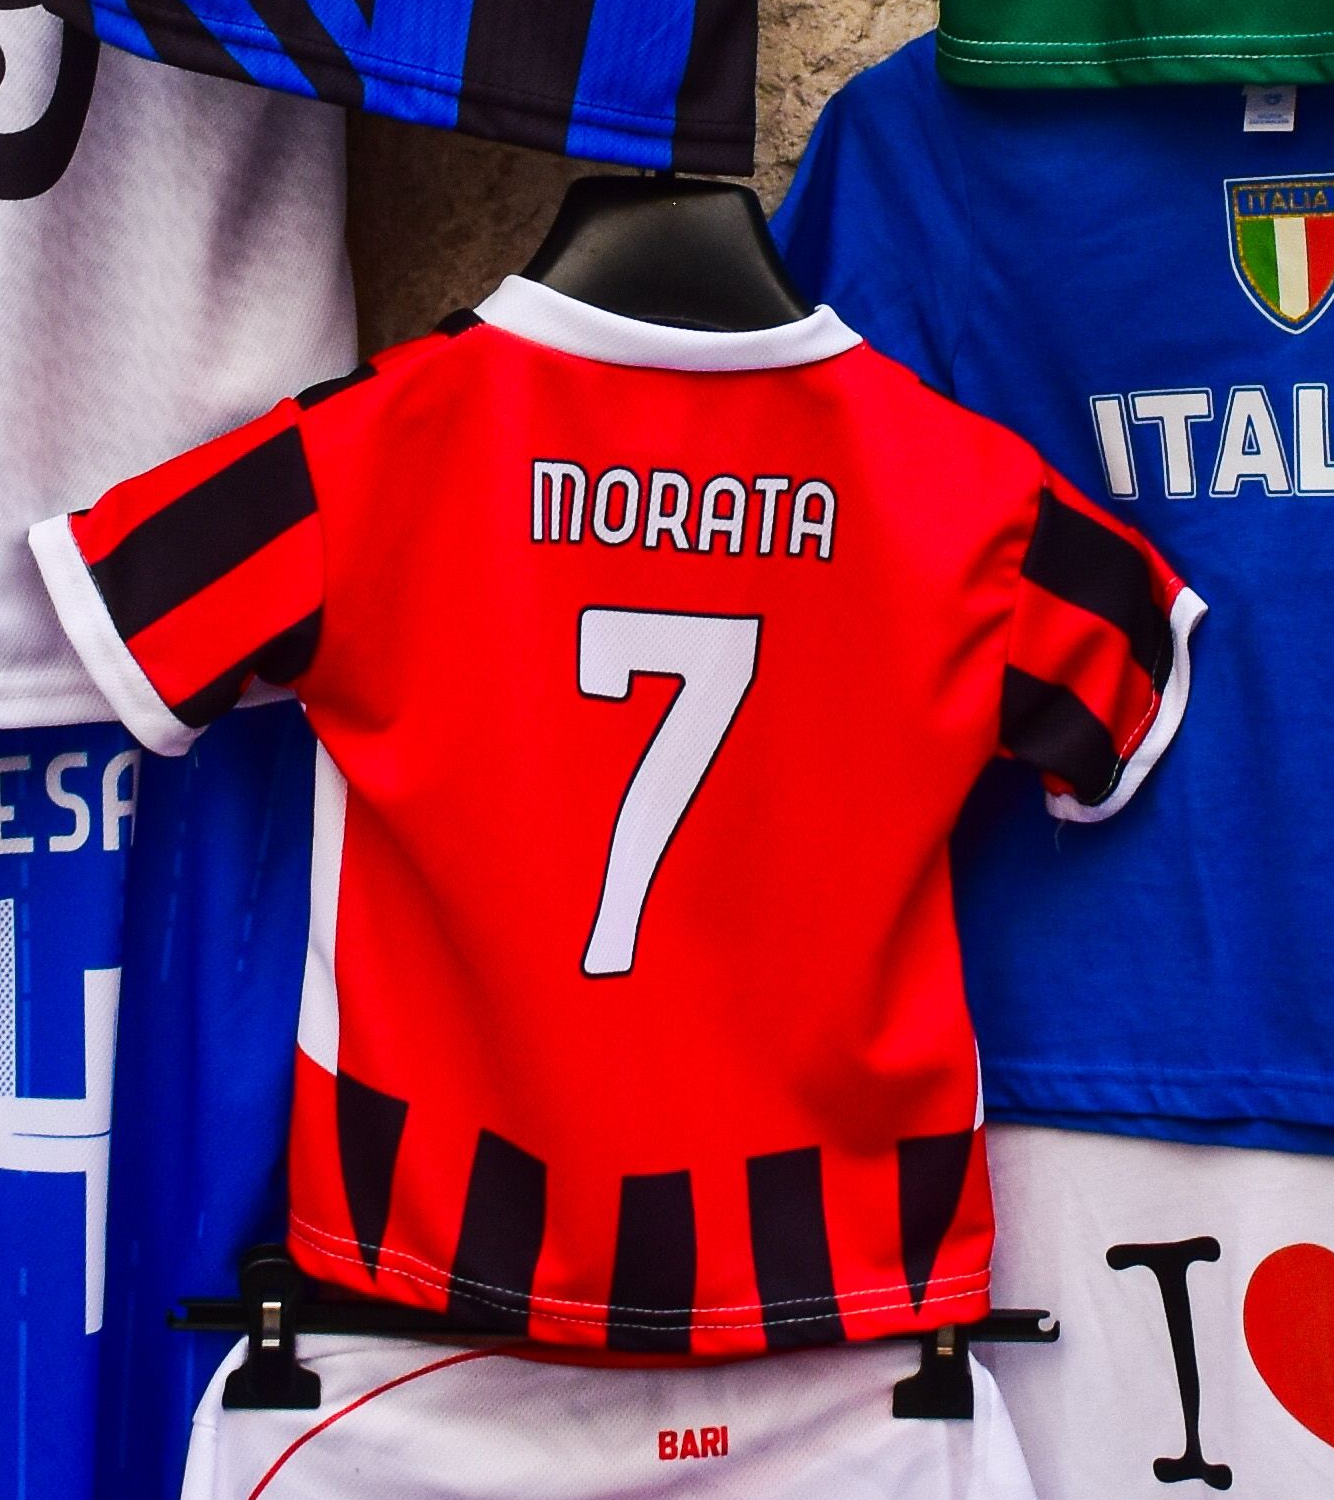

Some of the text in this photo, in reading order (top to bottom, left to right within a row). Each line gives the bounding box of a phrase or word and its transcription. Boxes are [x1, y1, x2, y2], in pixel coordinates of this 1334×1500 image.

[1246, 189, 1329, 212] ITALIA
[531, 458, 837, 561] MORATA
[577, 606, 763, 977] 7
[1105, 1235, 1233, 1491] I
[657, 1425, 730, 1462] BARI
